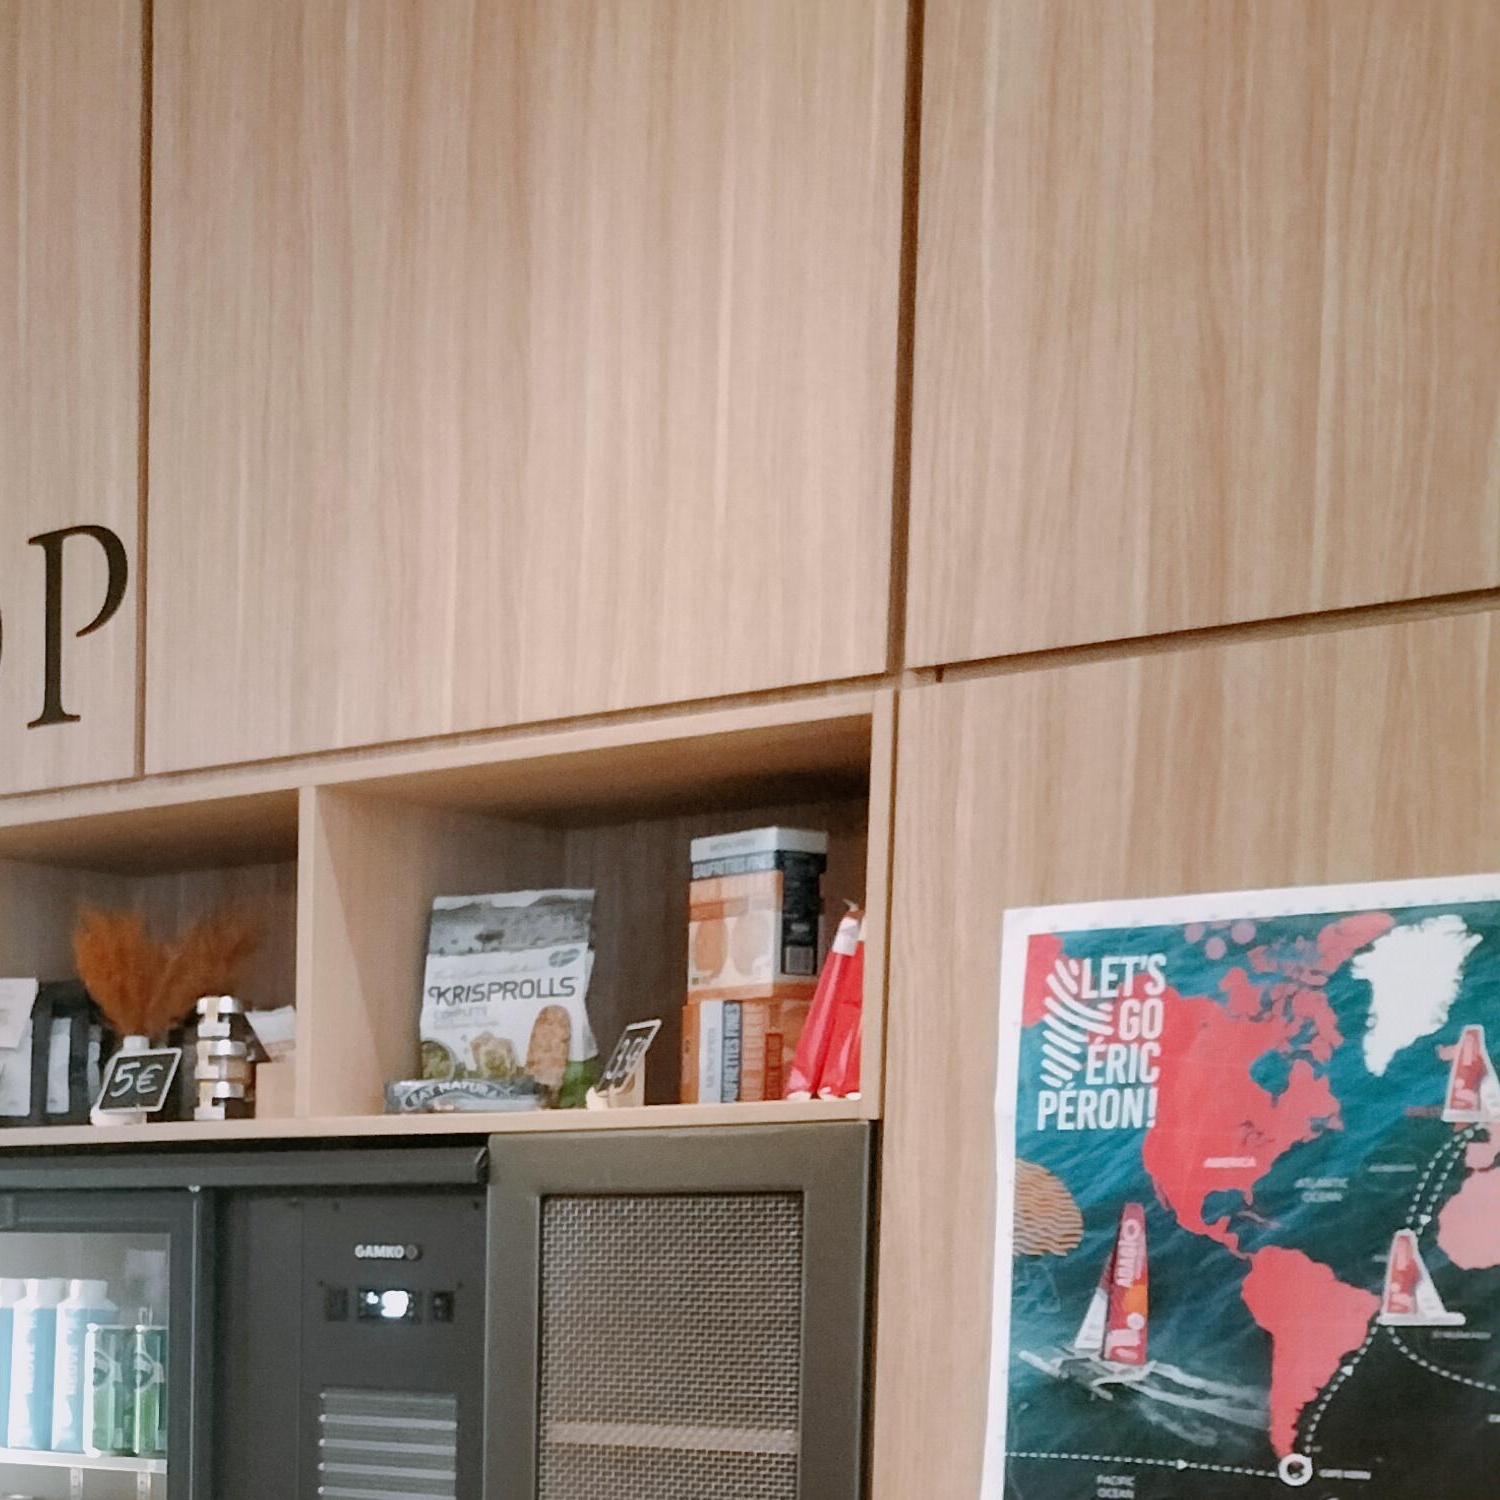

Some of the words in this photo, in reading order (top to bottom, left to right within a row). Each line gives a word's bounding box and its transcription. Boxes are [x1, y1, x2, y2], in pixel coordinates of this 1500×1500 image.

[427, 976, 577, 1006] KRISPROLLS
[1079, 953, 1167, 999] LET'S
[1118, 998, 1164, 1042] GO
[109, 1062, 164, 1098] 5€
[1086, 1041, 1161, 1085] ÉRIC
[1037, 1083, 1159, 1132] PÉRON!
[355, 1244, 405, 1259] GAMKO
